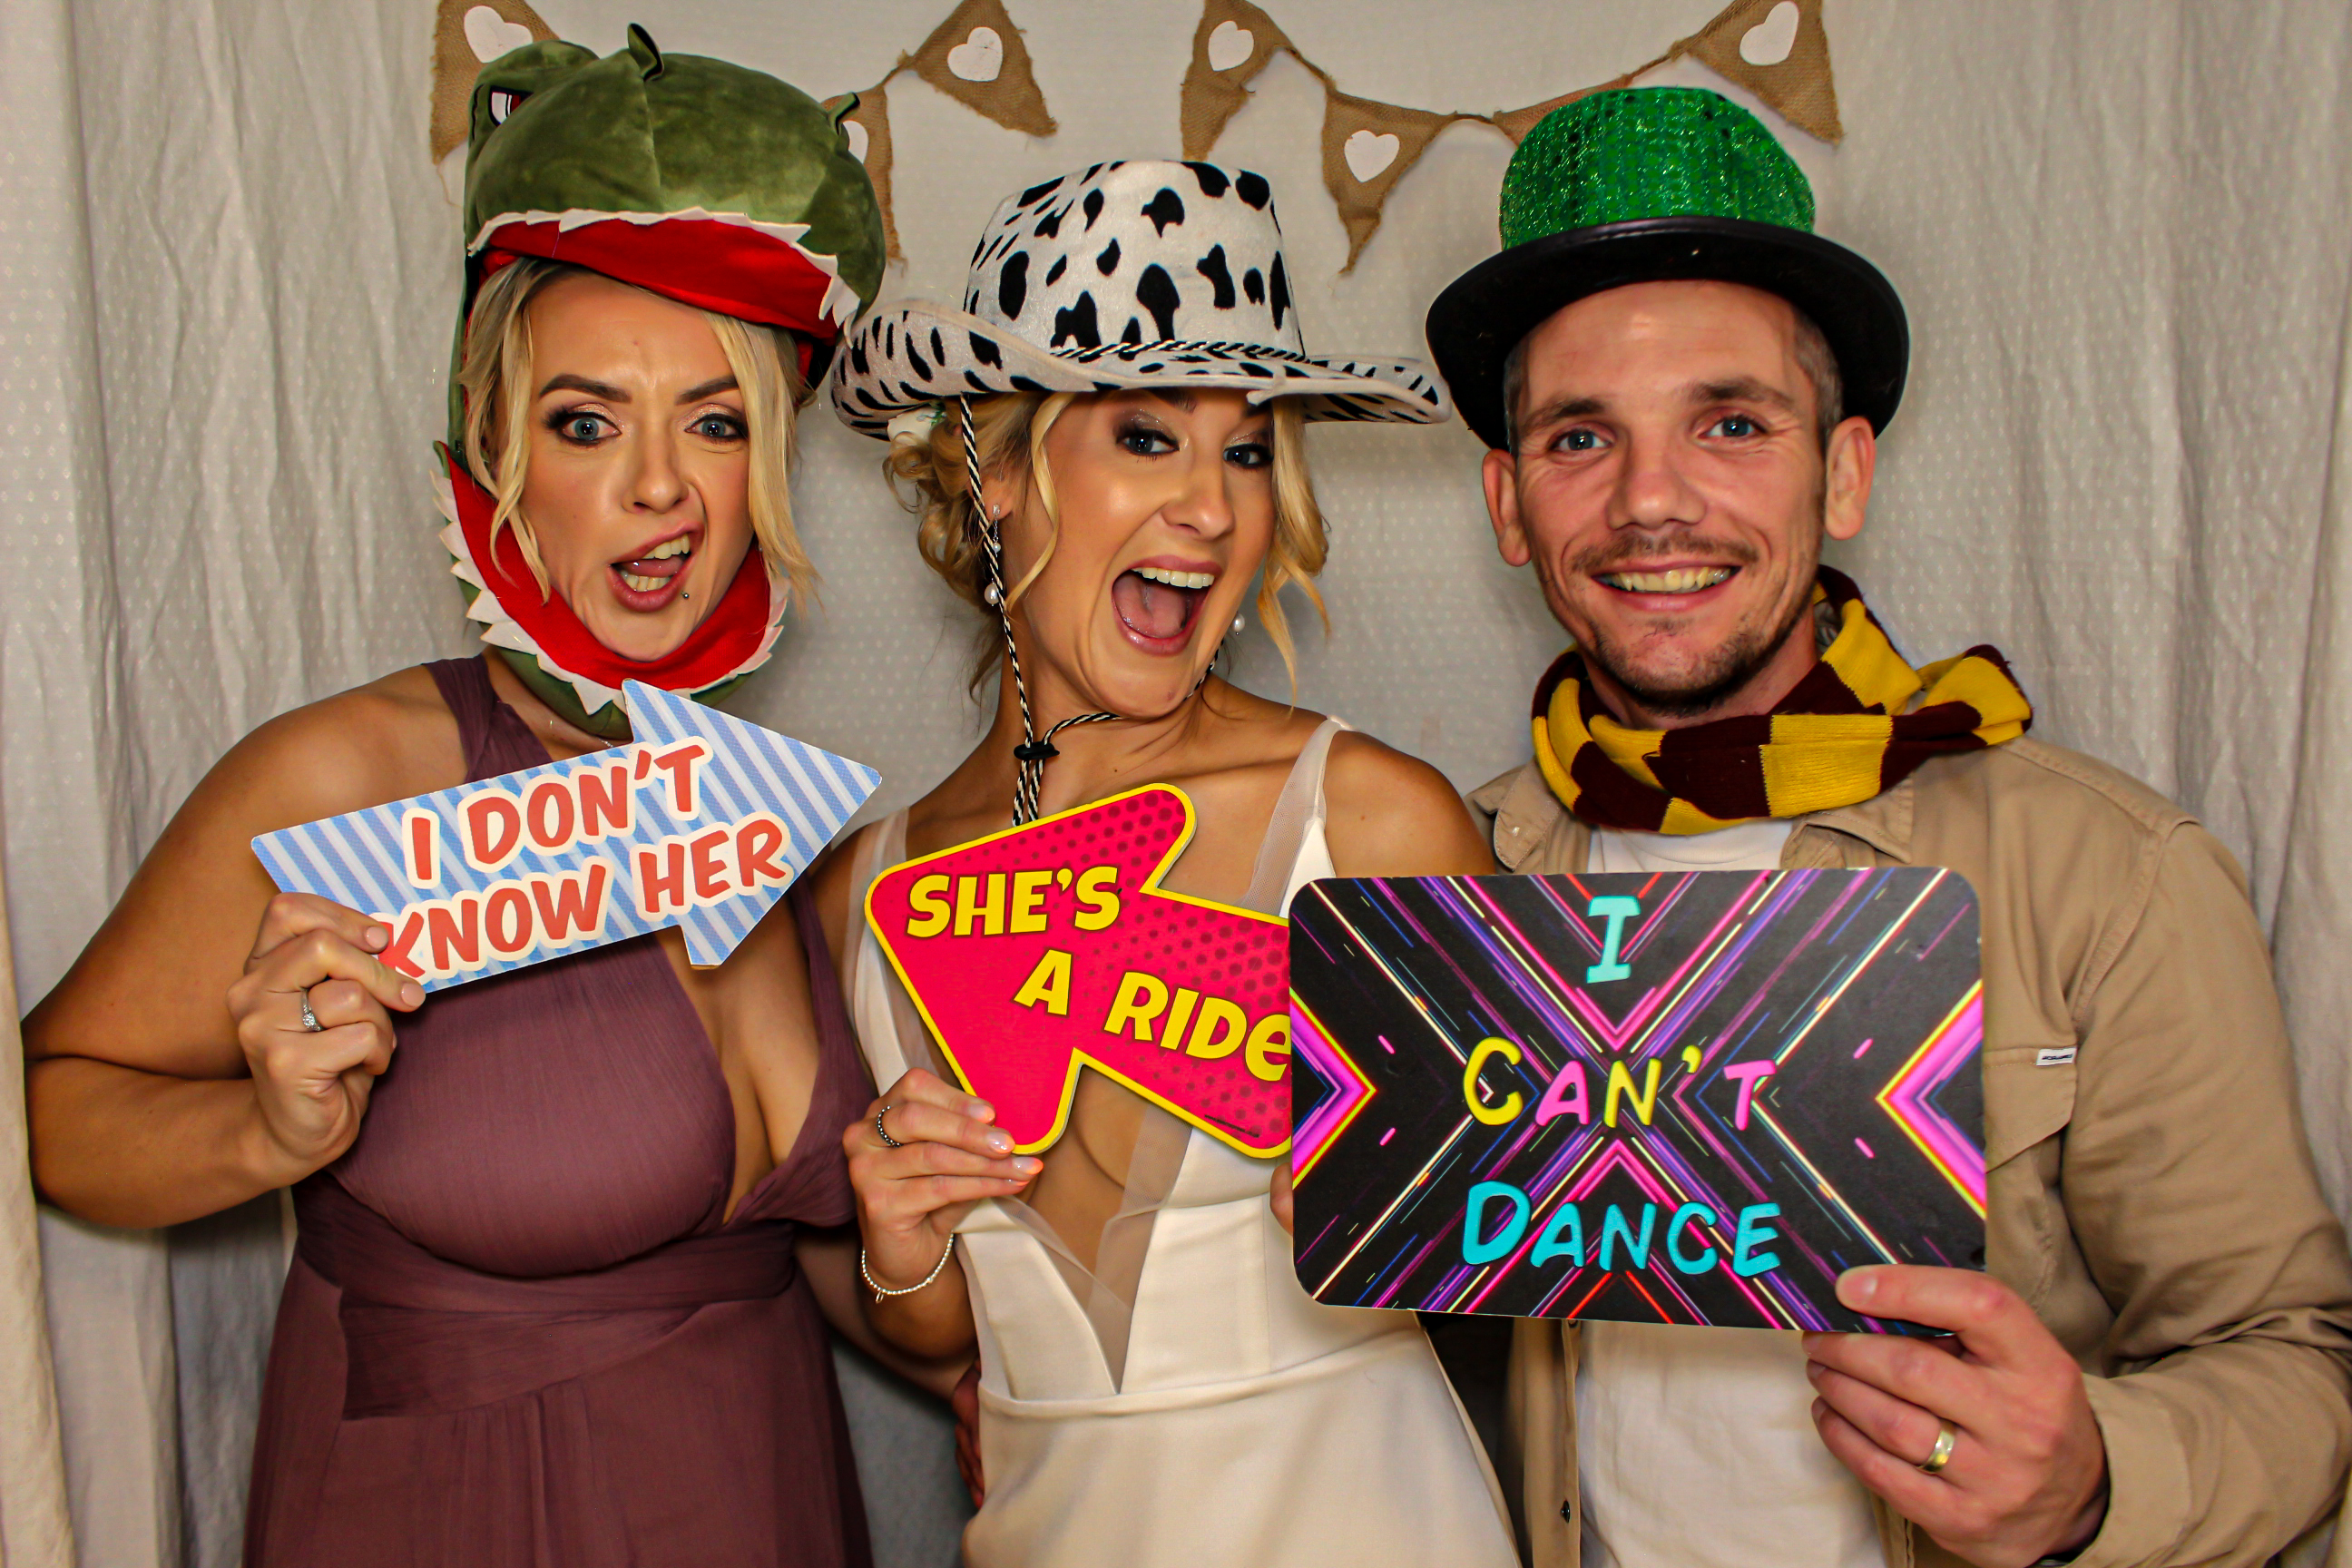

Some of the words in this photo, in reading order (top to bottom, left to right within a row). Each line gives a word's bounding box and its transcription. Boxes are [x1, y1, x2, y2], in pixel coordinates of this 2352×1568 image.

[411, 817, 432, 881] I
[466, 744, 706, 865] DON'T
[377, 863, 607, 978] KNOW
[639, 818, 788, 914] HER
[907, 866, 1120, 938] SHE'S
[1586, 895, 1642, 984] I
[1014, 949, 1073, 1015] A
[1463, 1036, 1777, 1131] CAN'T
[1462, 1181, 1782, 1278] DANCE
